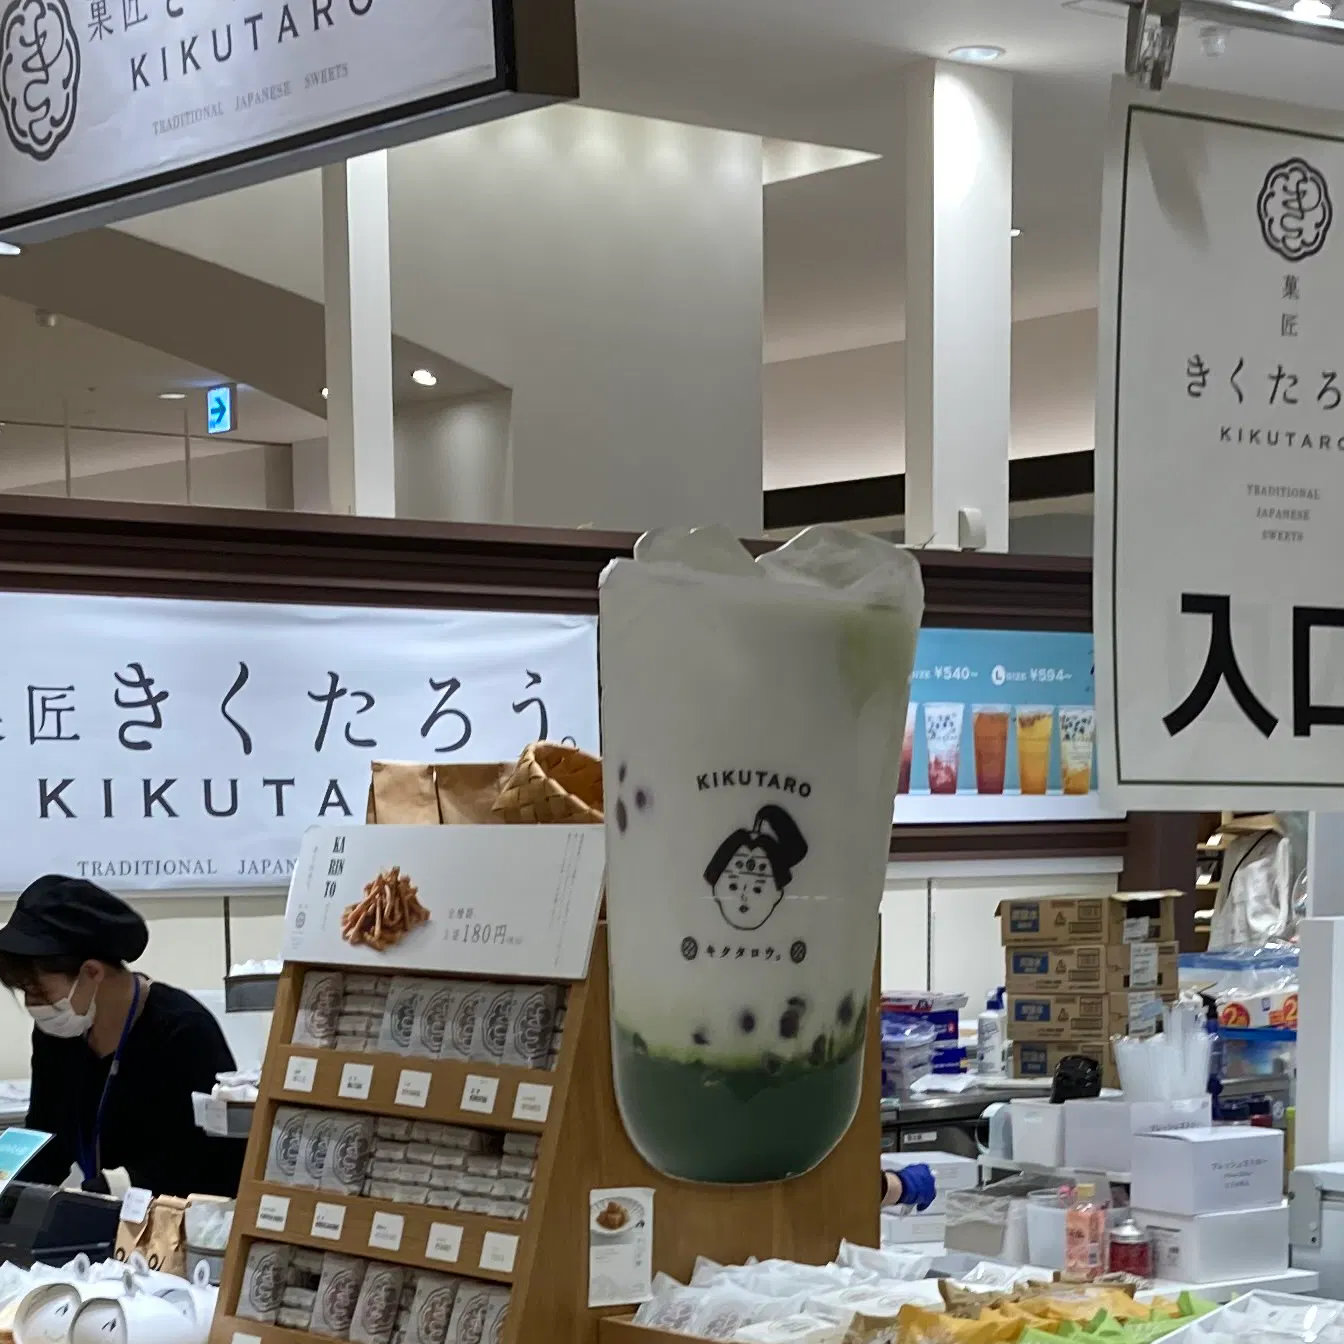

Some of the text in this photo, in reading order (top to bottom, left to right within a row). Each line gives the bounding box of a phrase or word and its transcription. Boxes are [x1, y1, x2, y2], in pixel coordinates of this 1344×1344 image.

[152, 62, 349, 136] TRADITIONAL JAPANESE SWEETS
[1246, 483, 1321, 500] TRADITIONAL
[1256, 506, 1311, 521] JAPANESE
[1261, 529, 1304, 542] SWEETS
[696, 769, 812, 798] KIKUTARO
[76, 857, 218, 880] TRADITIONAL
[323, 881, 337, 899] TO
